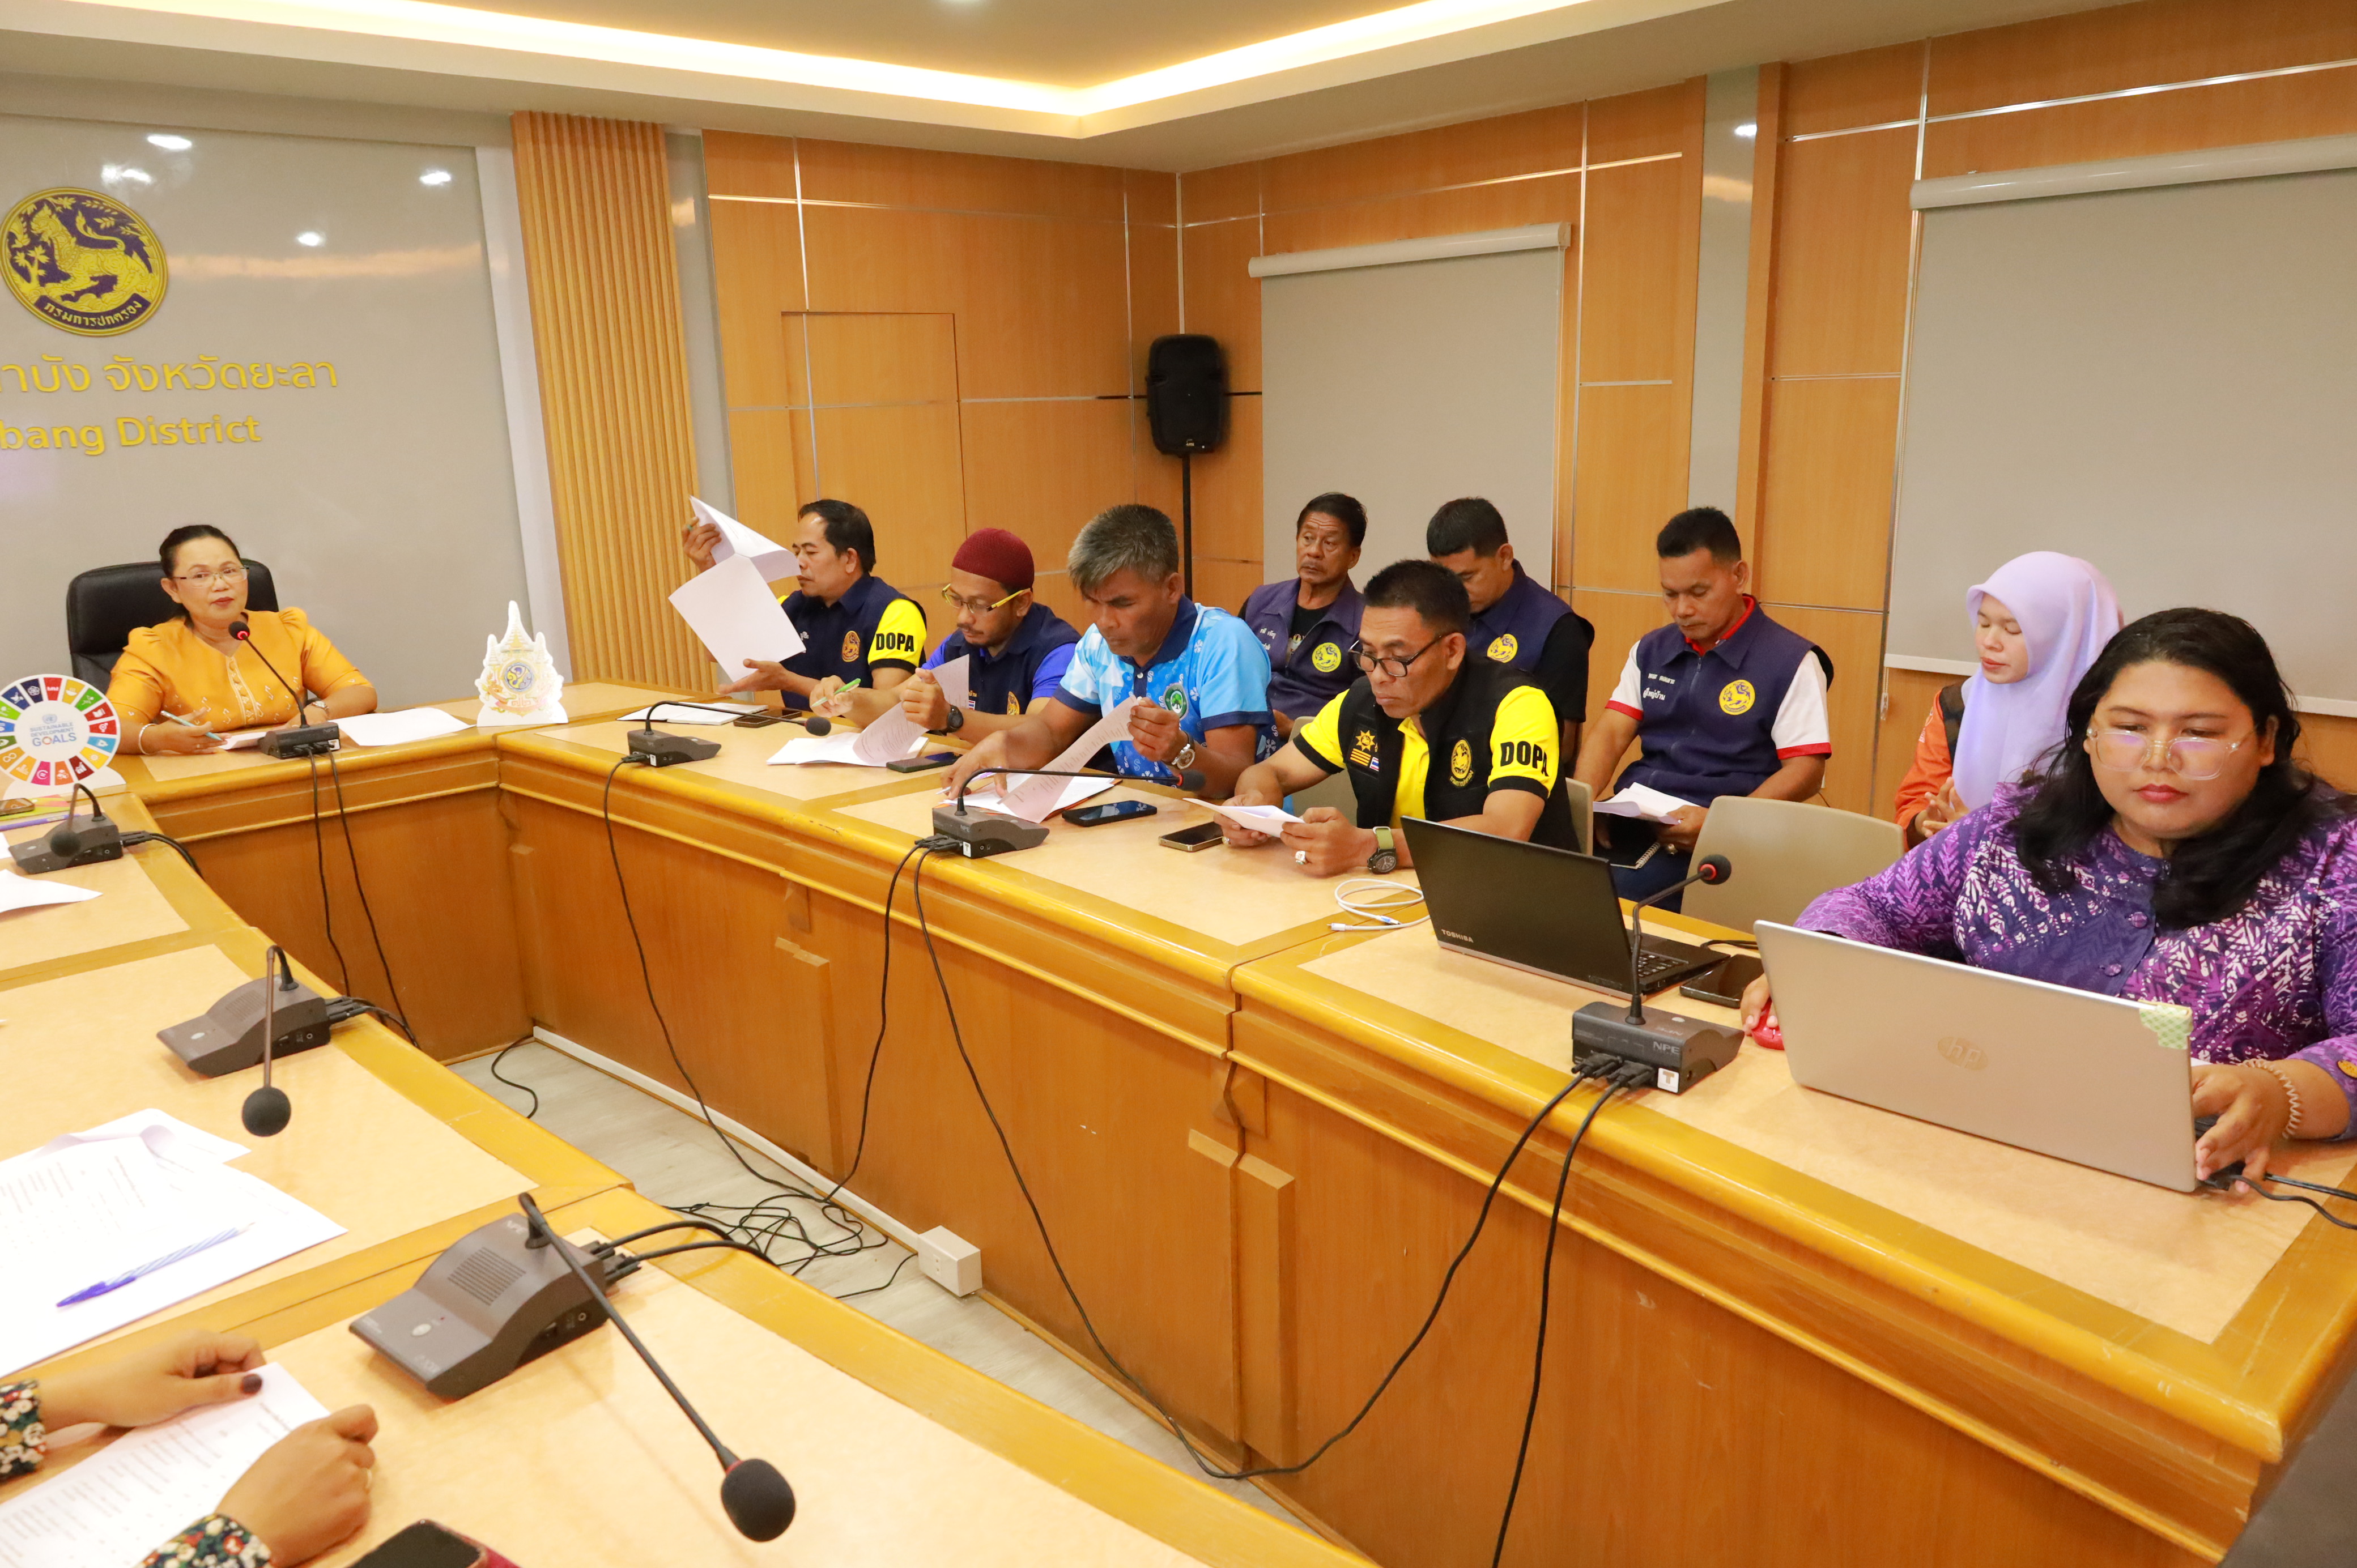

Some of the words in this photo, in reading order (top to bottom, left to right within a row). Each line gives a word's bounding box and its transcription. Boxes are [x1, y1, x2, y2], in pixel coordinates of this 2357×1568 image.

[43, 299, 143, 327] กรมการปกครอง
[0, 353, 91, 393] าบัง
[103, 354, 338, 391] จังหวัดยะลา
[116, 414, 262, 446] District
[876, 632, 914, 652] DOPA
[30, 722, 74, 732] SUSTAINABLE
[31, 727, 74, 738] DEVELOPMENT
[32, 732, 77, 747] GOALS
[1500, 740, 1549, 777] DOPA
[1441, 929, 1474, 943] TOSHIBA
[1653, 1041, 1680, 1055] NPE
